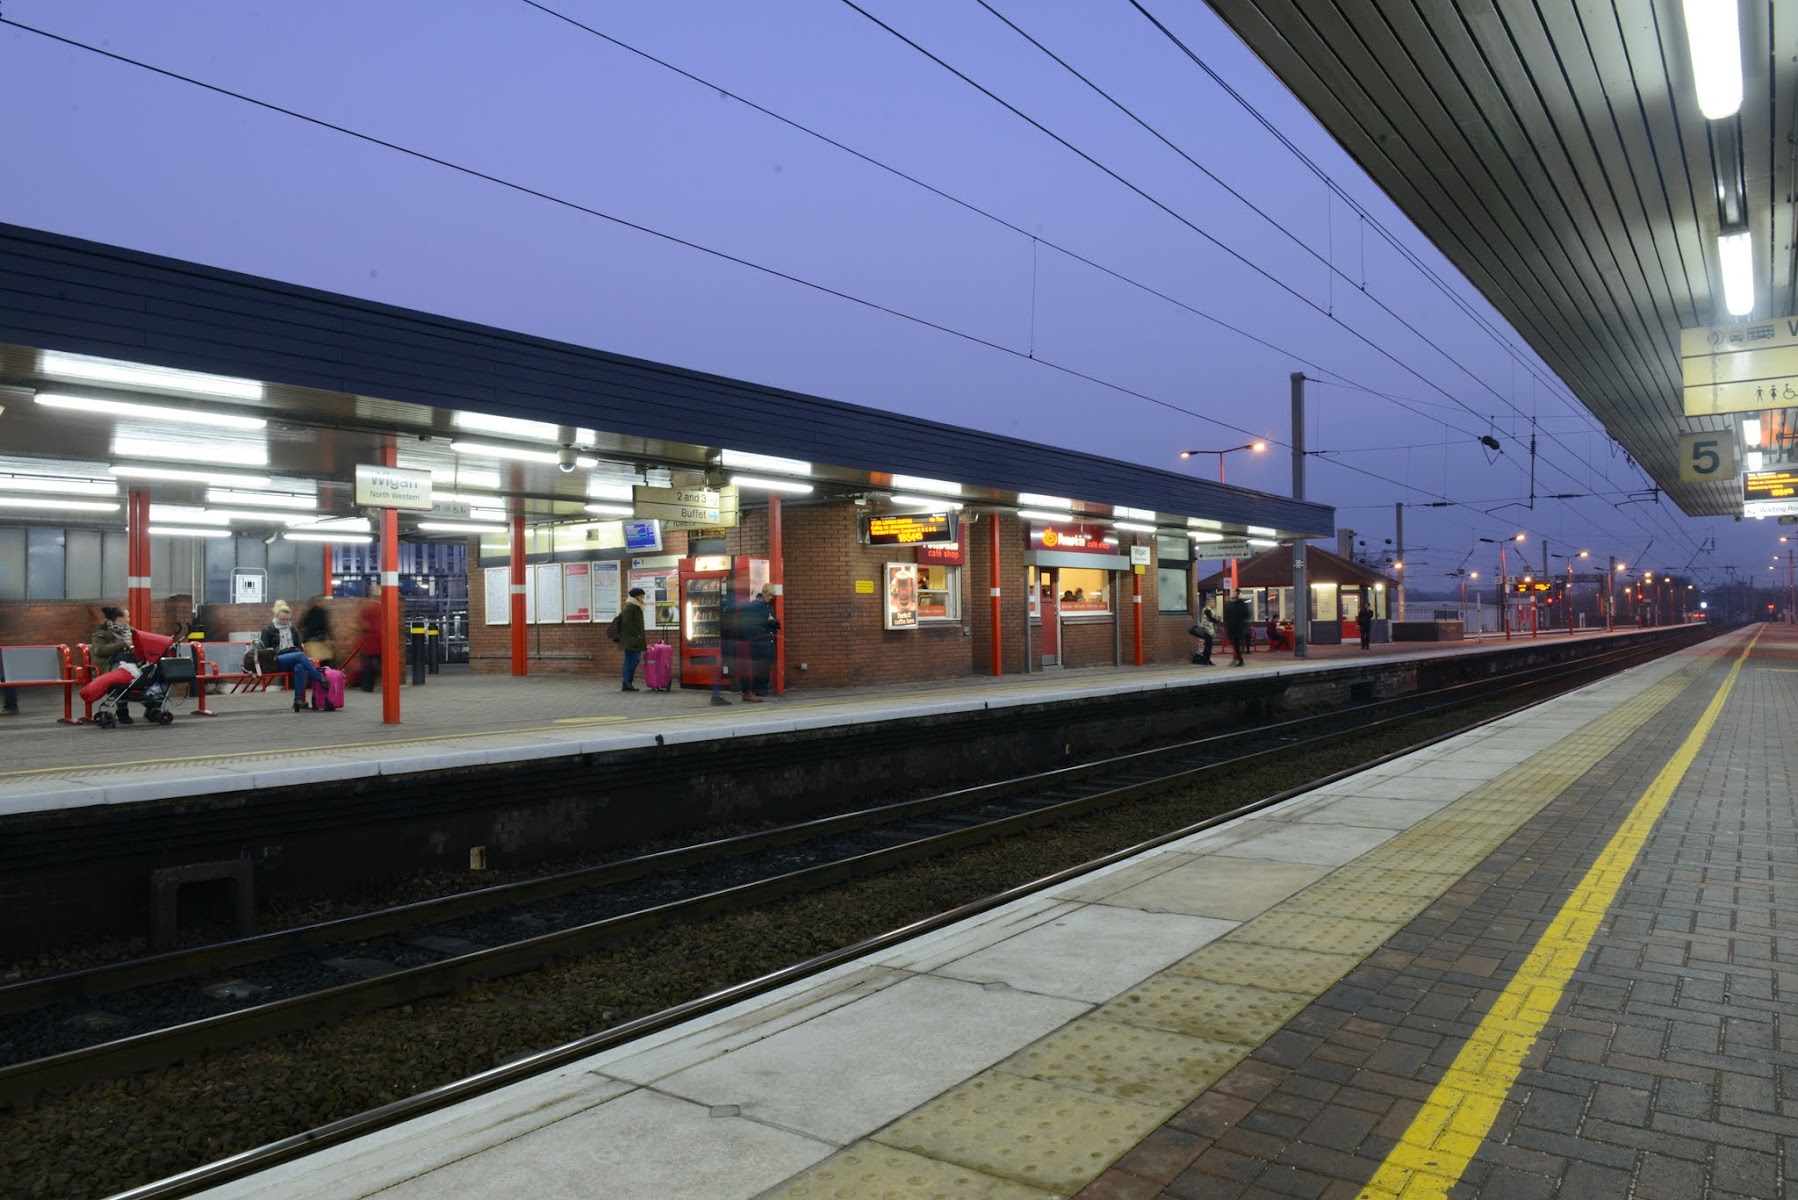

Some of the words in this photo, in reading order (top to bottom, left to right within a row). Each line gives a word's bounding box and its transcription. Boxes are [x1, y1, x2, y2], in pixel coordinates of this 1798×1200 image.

[1692, 440, 1720, 474] 5
[371, 471, 418, 490] Wigan
[370, 490, 390, 499] North
[391, 492, 420, 501] Western
[677, 491, 682, 501] 2
[685, 493, 700, 503] and
[701, 494, 707, 504] 3
[681, 508, 707, 520] Buffet
[1760, 505, 1787, 513] Waiting
[928, 549, 942, 557] café
[943, 550, 959, 560] shop
